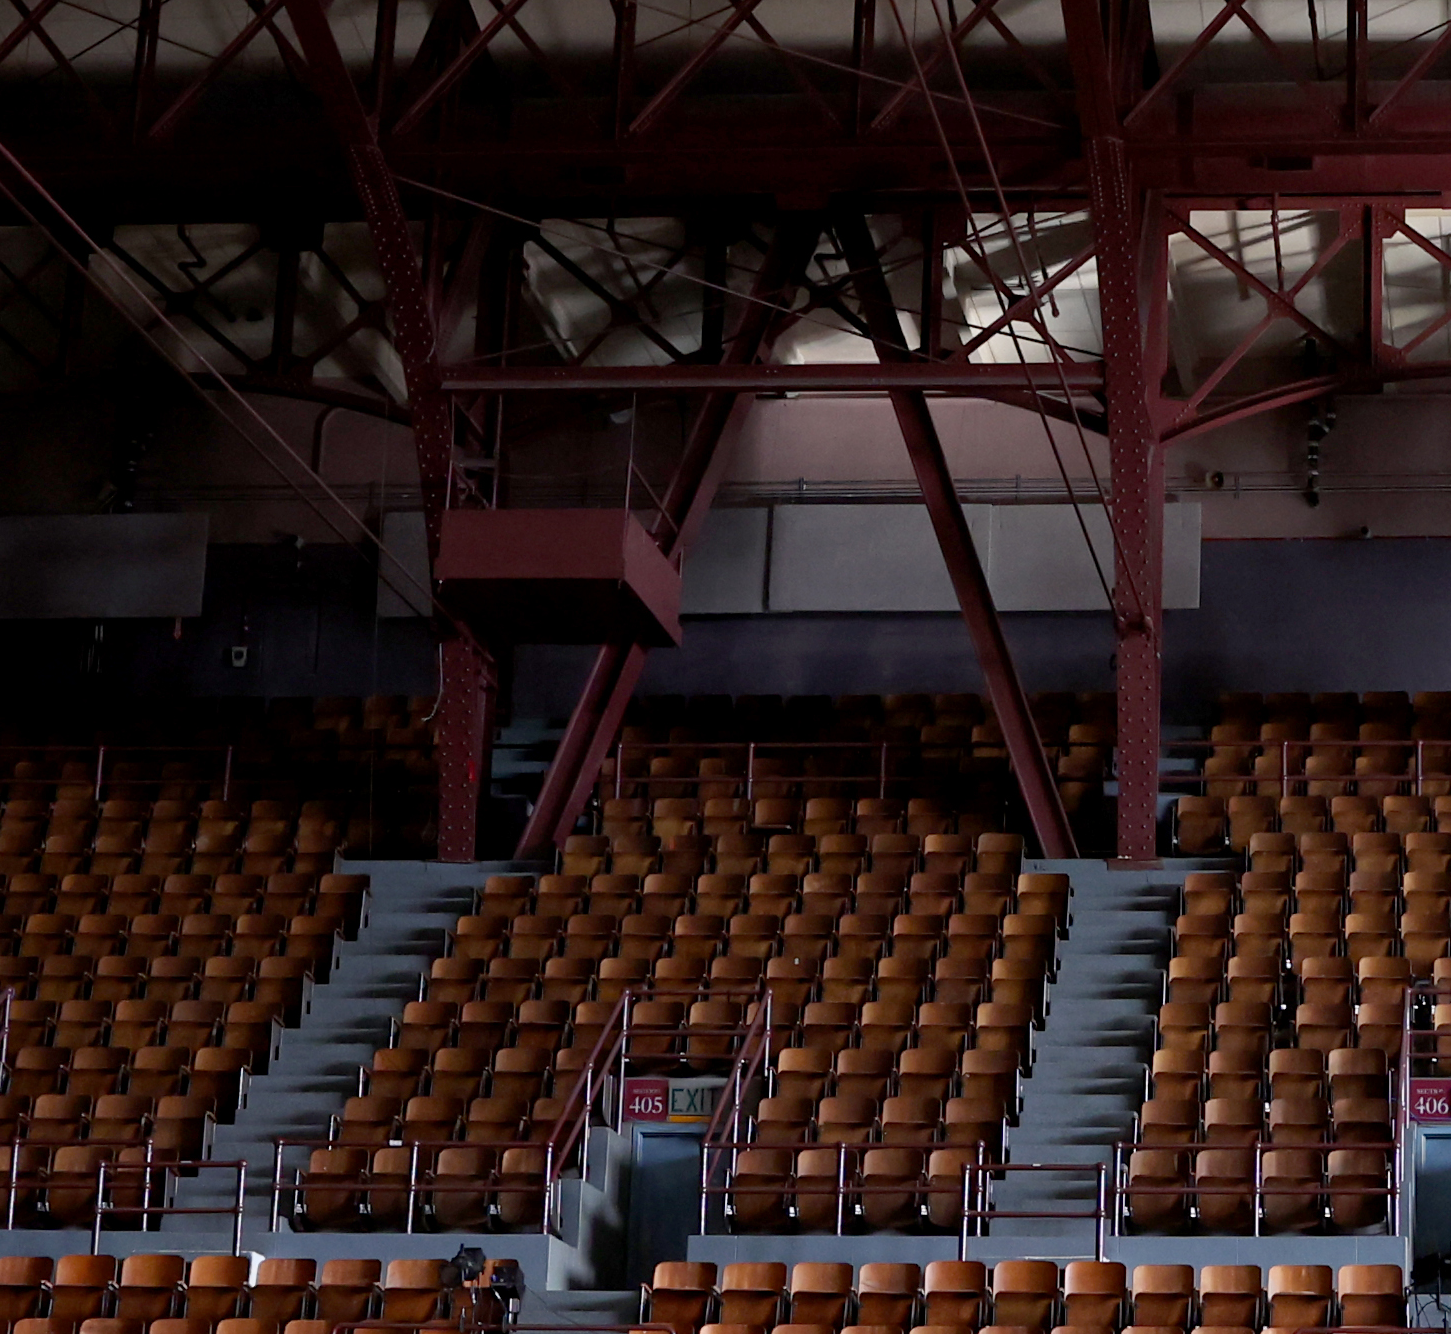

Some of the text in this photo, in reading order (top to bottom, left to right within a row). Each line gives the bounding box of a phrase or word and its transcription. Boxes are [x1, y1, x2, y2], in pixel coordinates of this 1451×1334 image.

[628, 1095, 663, 1114] 405
[671, 1088, 718, 1112] EXIT
[1413, 1096, 1449, 1114] 406
